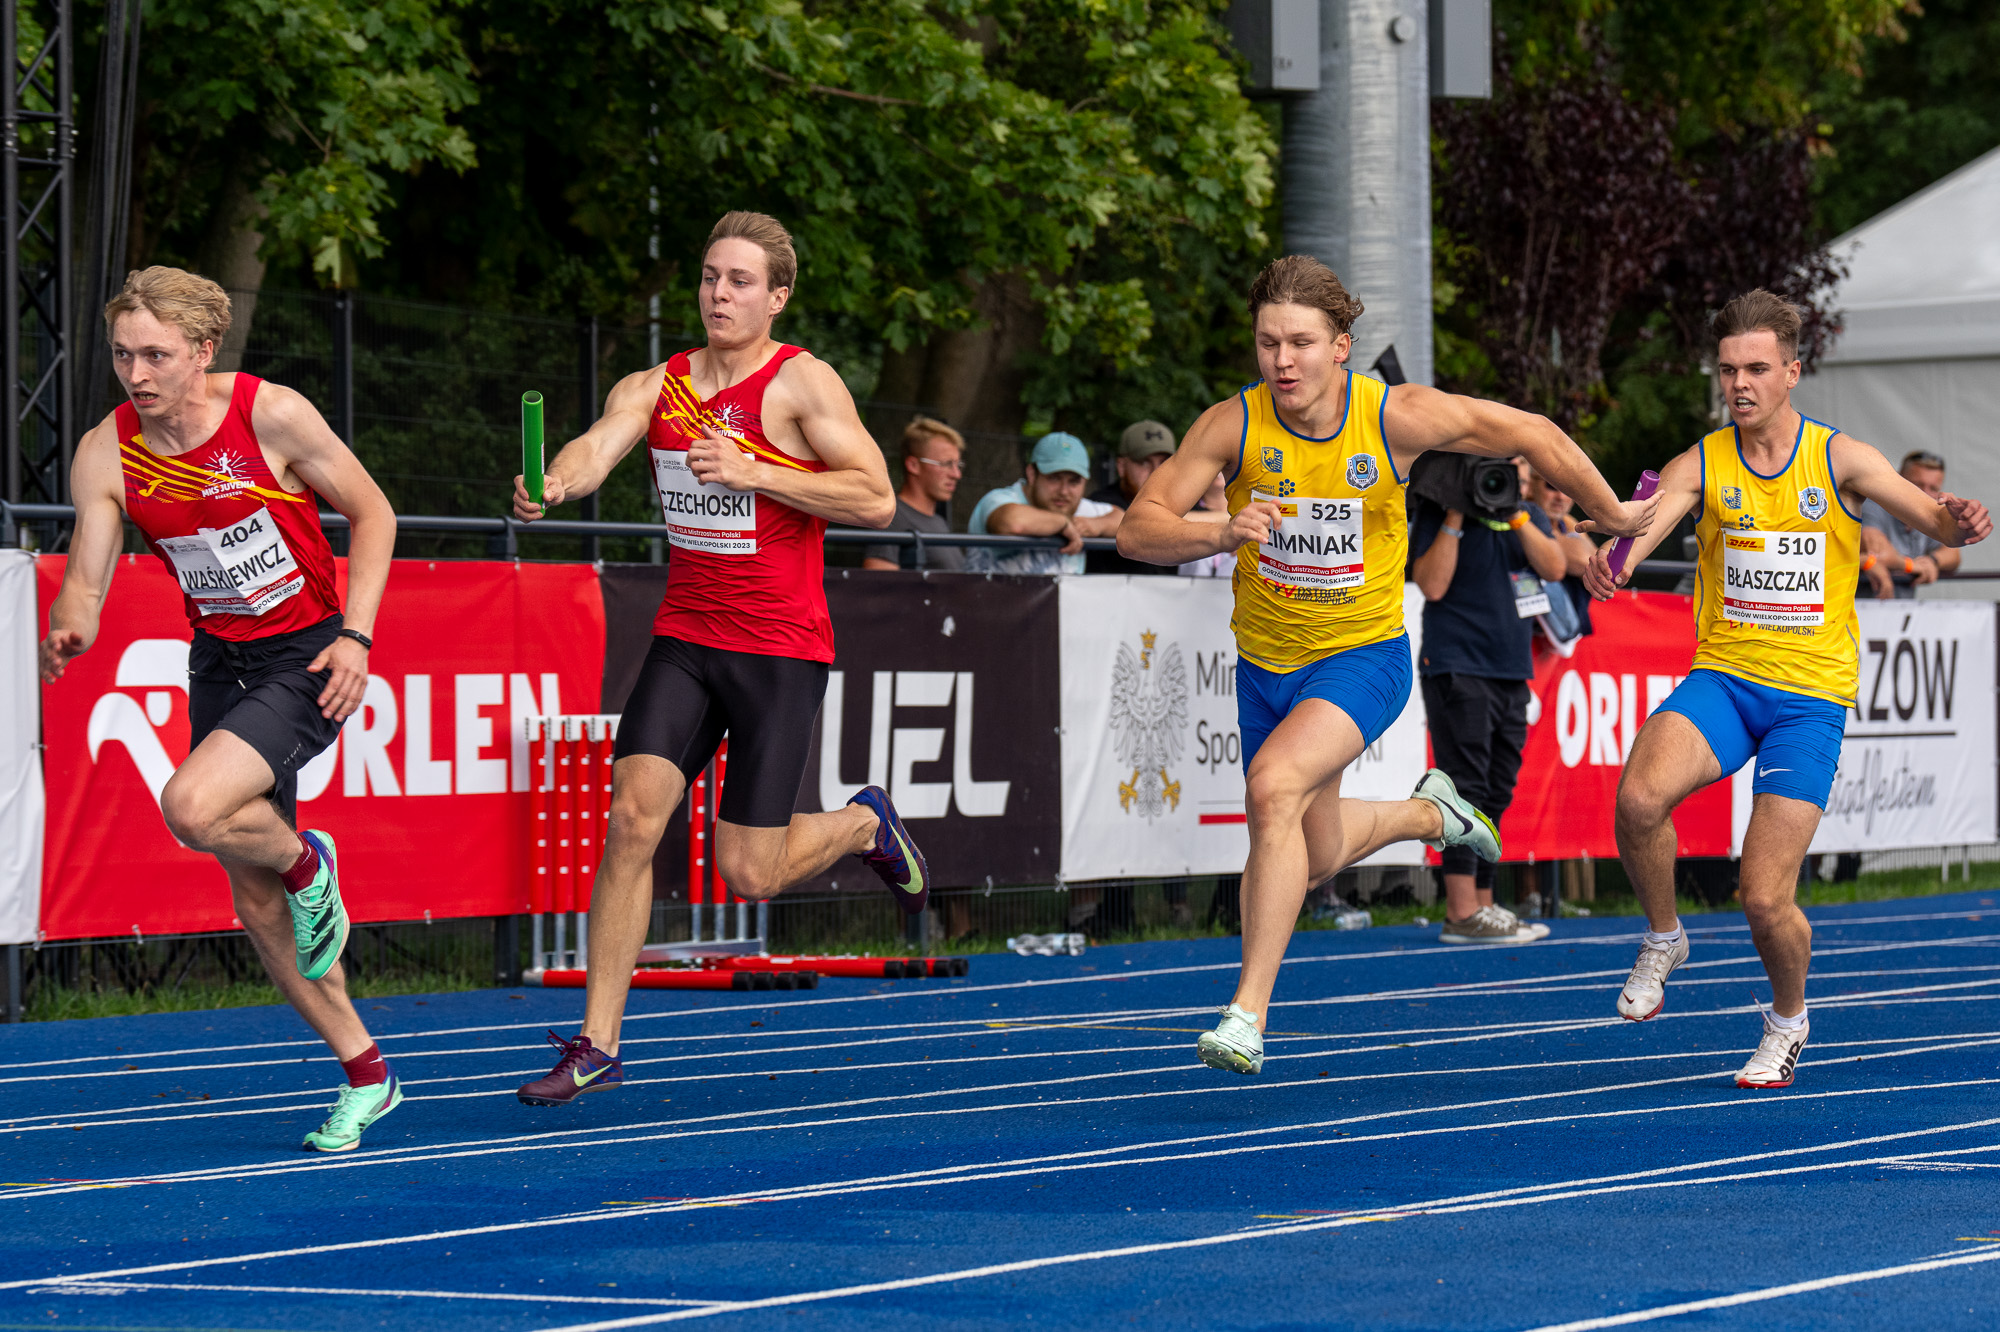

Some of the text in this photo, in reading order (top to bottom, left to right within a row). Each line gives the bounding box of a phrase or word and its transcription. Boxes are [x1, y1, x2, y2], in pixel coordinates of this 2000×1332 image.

[201, 480, 256, 498] MKS JUVENIA
[1311, 503, 1352, 521] 525
[220, 518, 263, 548] 404
[676, 526, 688, 535] PZLA
[688, 528, 720, 538] Mistrzostwa
[721, 530, 741, 538] Polski
[687, 539, 732, 549] WIELKOPOLSKI
[1729, 538, 1758, 548] DHL
[1777, 537, 1817, 555] 510
[182, 542, 286, 591] WAŚKIEWICZ
[1269, 559, 1350, 575] 99. PZLA Mistrzostwa Polski
[1261, 566, 1360, 585] GORZÓW WIELKOPOLSKI 2023
[1727, 566, 1820, 592] BŁASZCZAK
[267, 577, 288, 592] Polski
[282, 581, 301, 595] 2023
[1294, 594, 1357, 605] WIELKOPOLSKI
[1733, 600, 1811, 612] 99. PZLA Mistrzostwa Polski
[1726, 609, 1819, 622] GORZÓW WIELKOPOLSKI 2023
[1556, 669, 1688, 769] ORL
